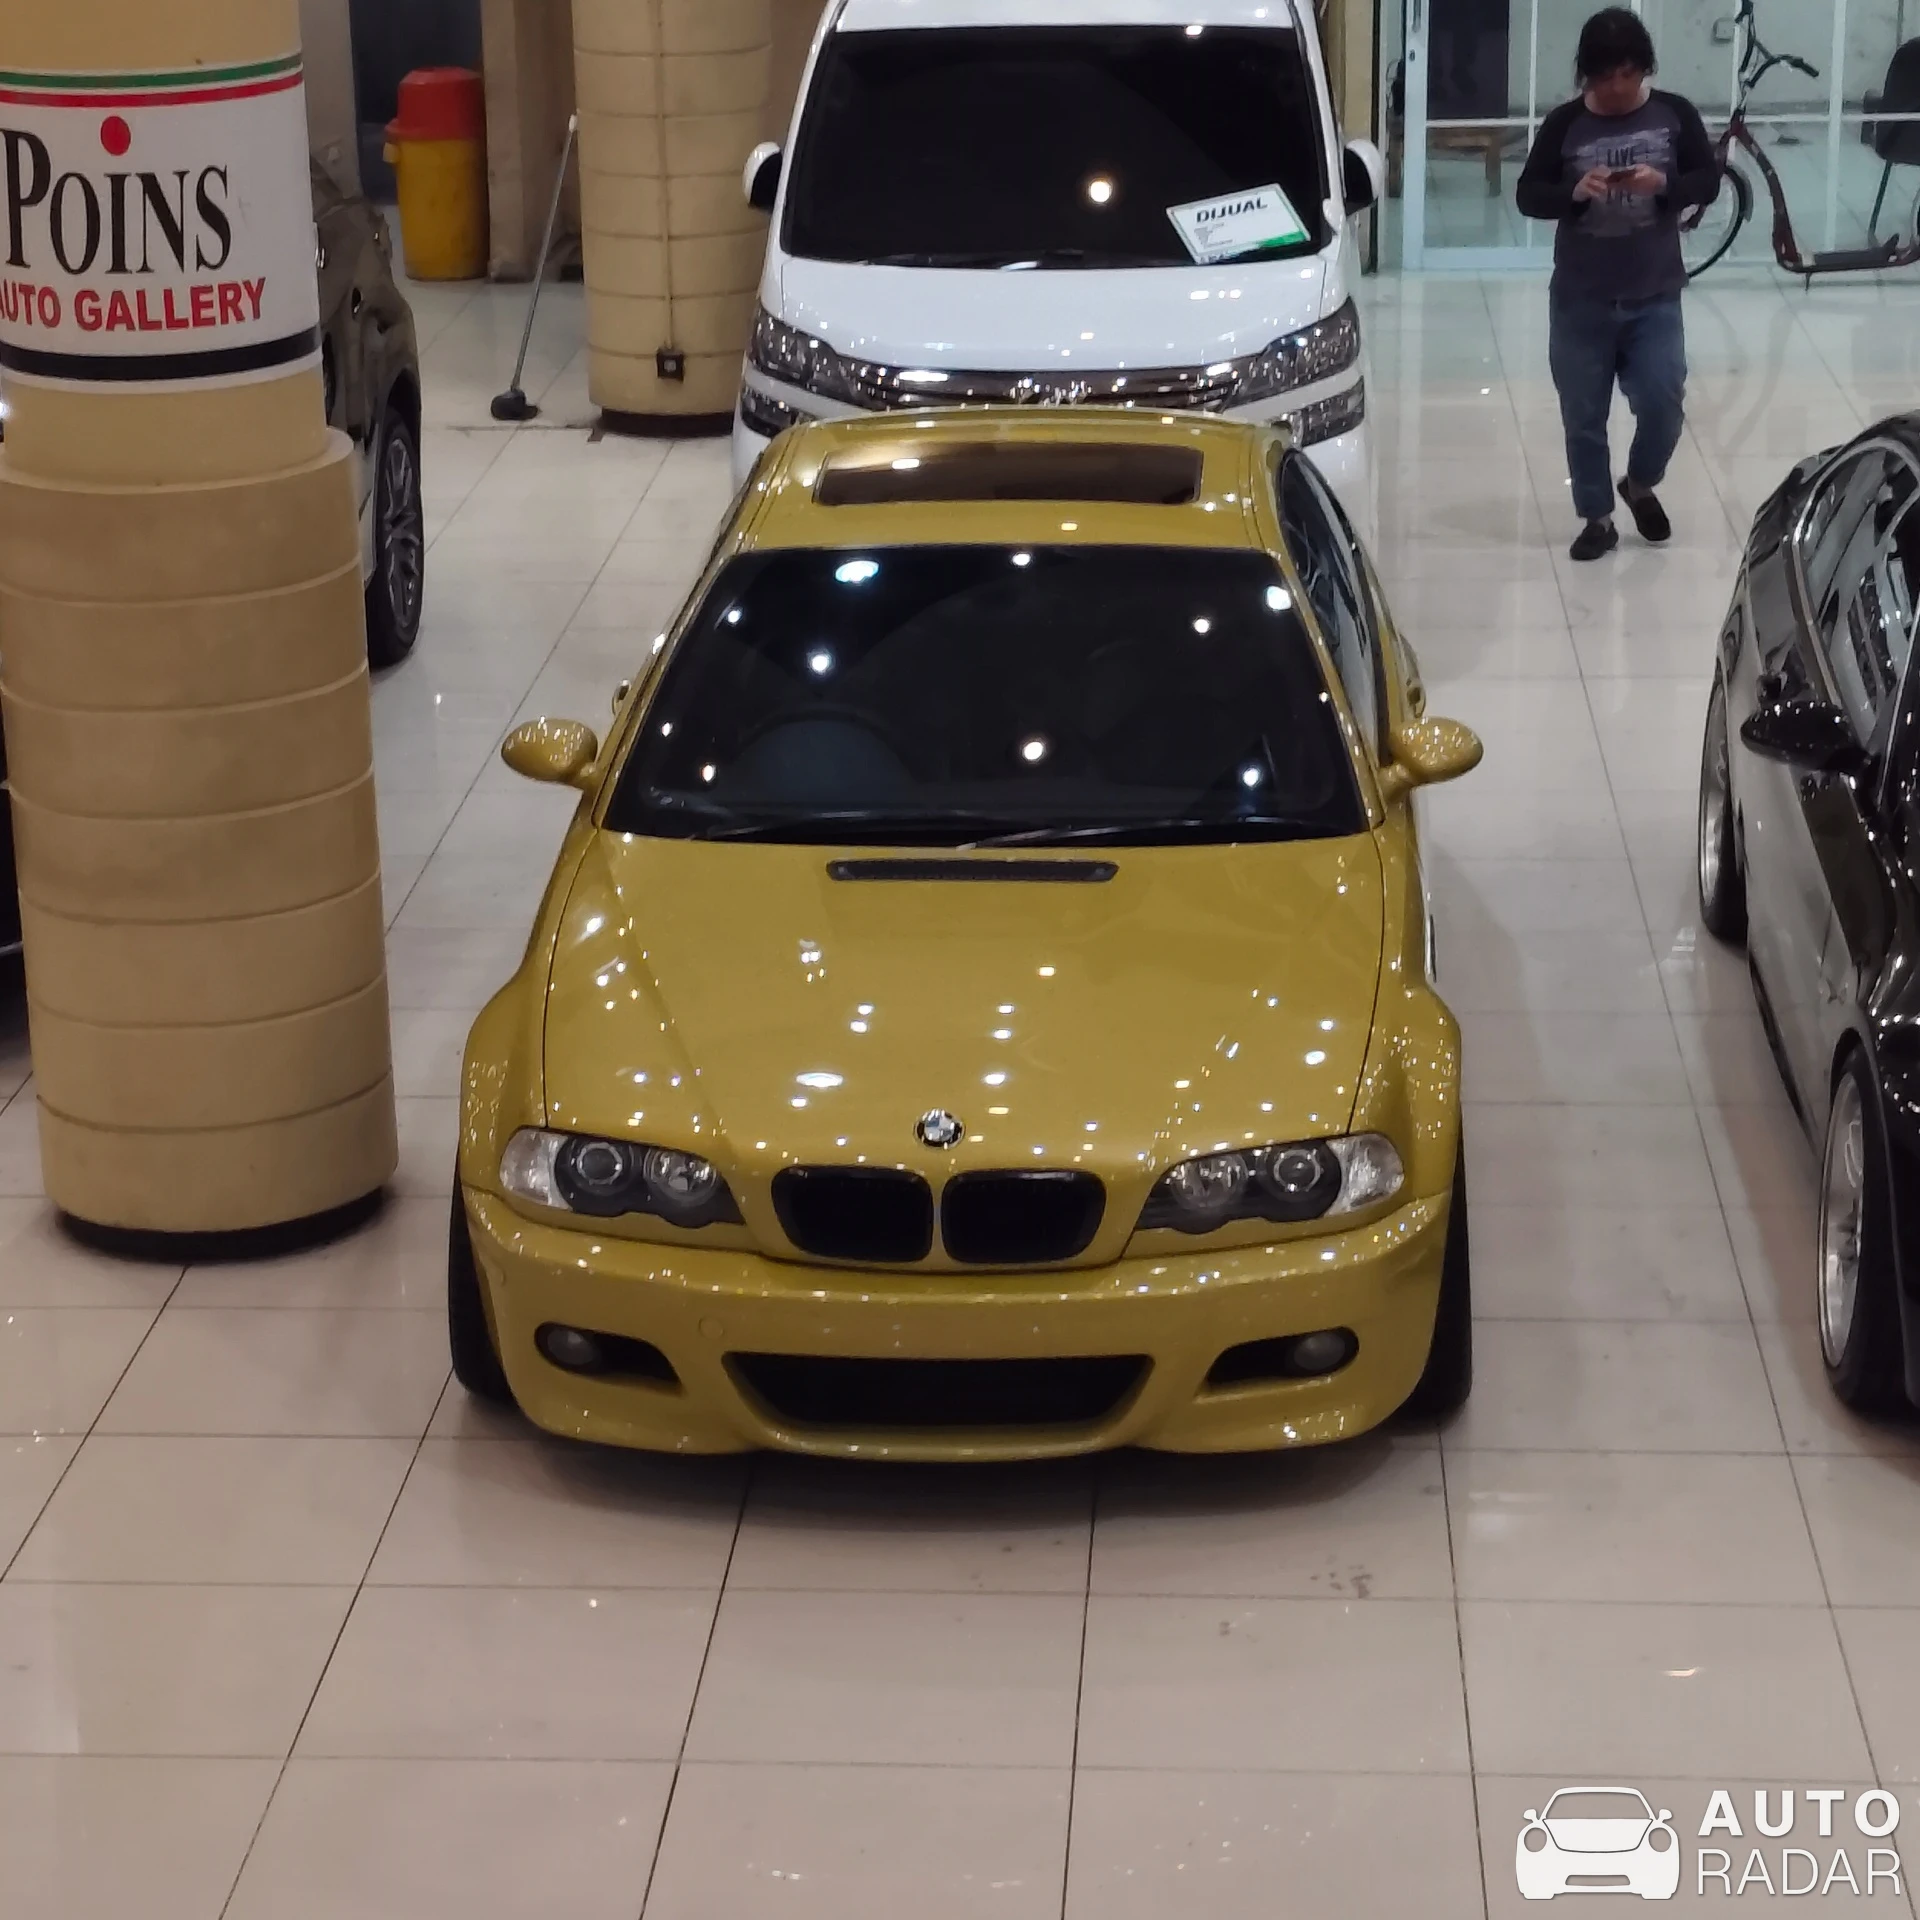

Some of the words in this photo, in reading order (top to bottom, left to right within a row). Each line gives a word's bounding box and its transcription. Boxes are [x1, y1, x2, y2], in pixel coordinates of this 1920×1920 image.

[0, 128, 232, 275] POINS
[1196, 196, 1268, 223] DIJUAL
[74, 277, 267, 332] GALLERY
